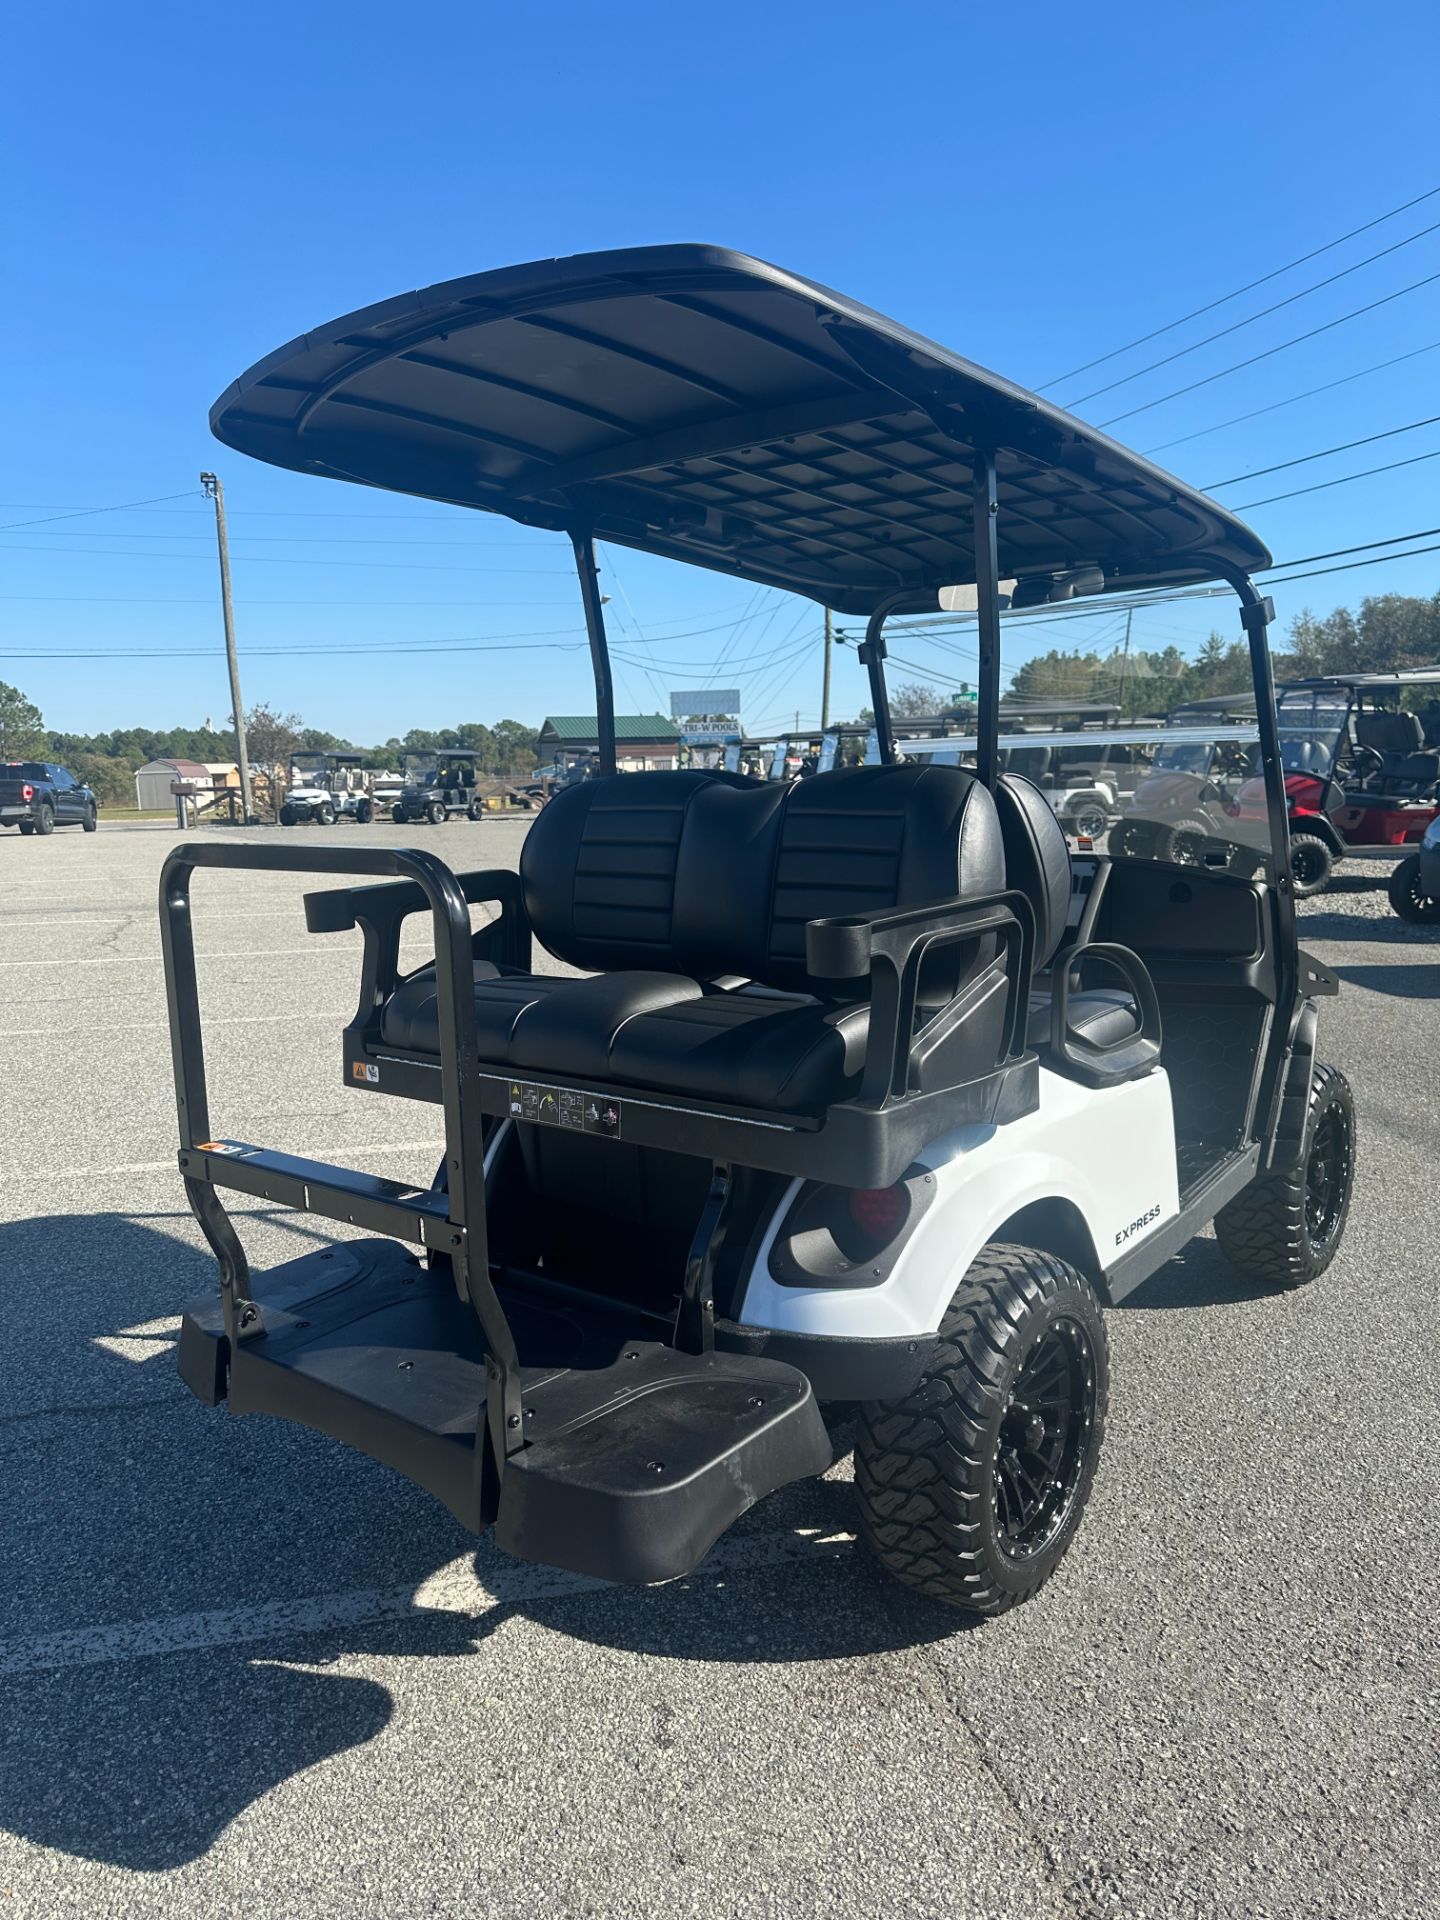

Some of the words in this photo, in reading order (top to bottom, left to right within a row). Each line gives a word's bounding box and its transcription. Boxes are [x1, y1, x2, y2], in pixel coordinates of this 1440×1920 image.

[683, 723, 711, 732] TRI-W
[712, 723, 738, 731] POOLS
[1115, 1204, 1161, 1246] EXPRESS
